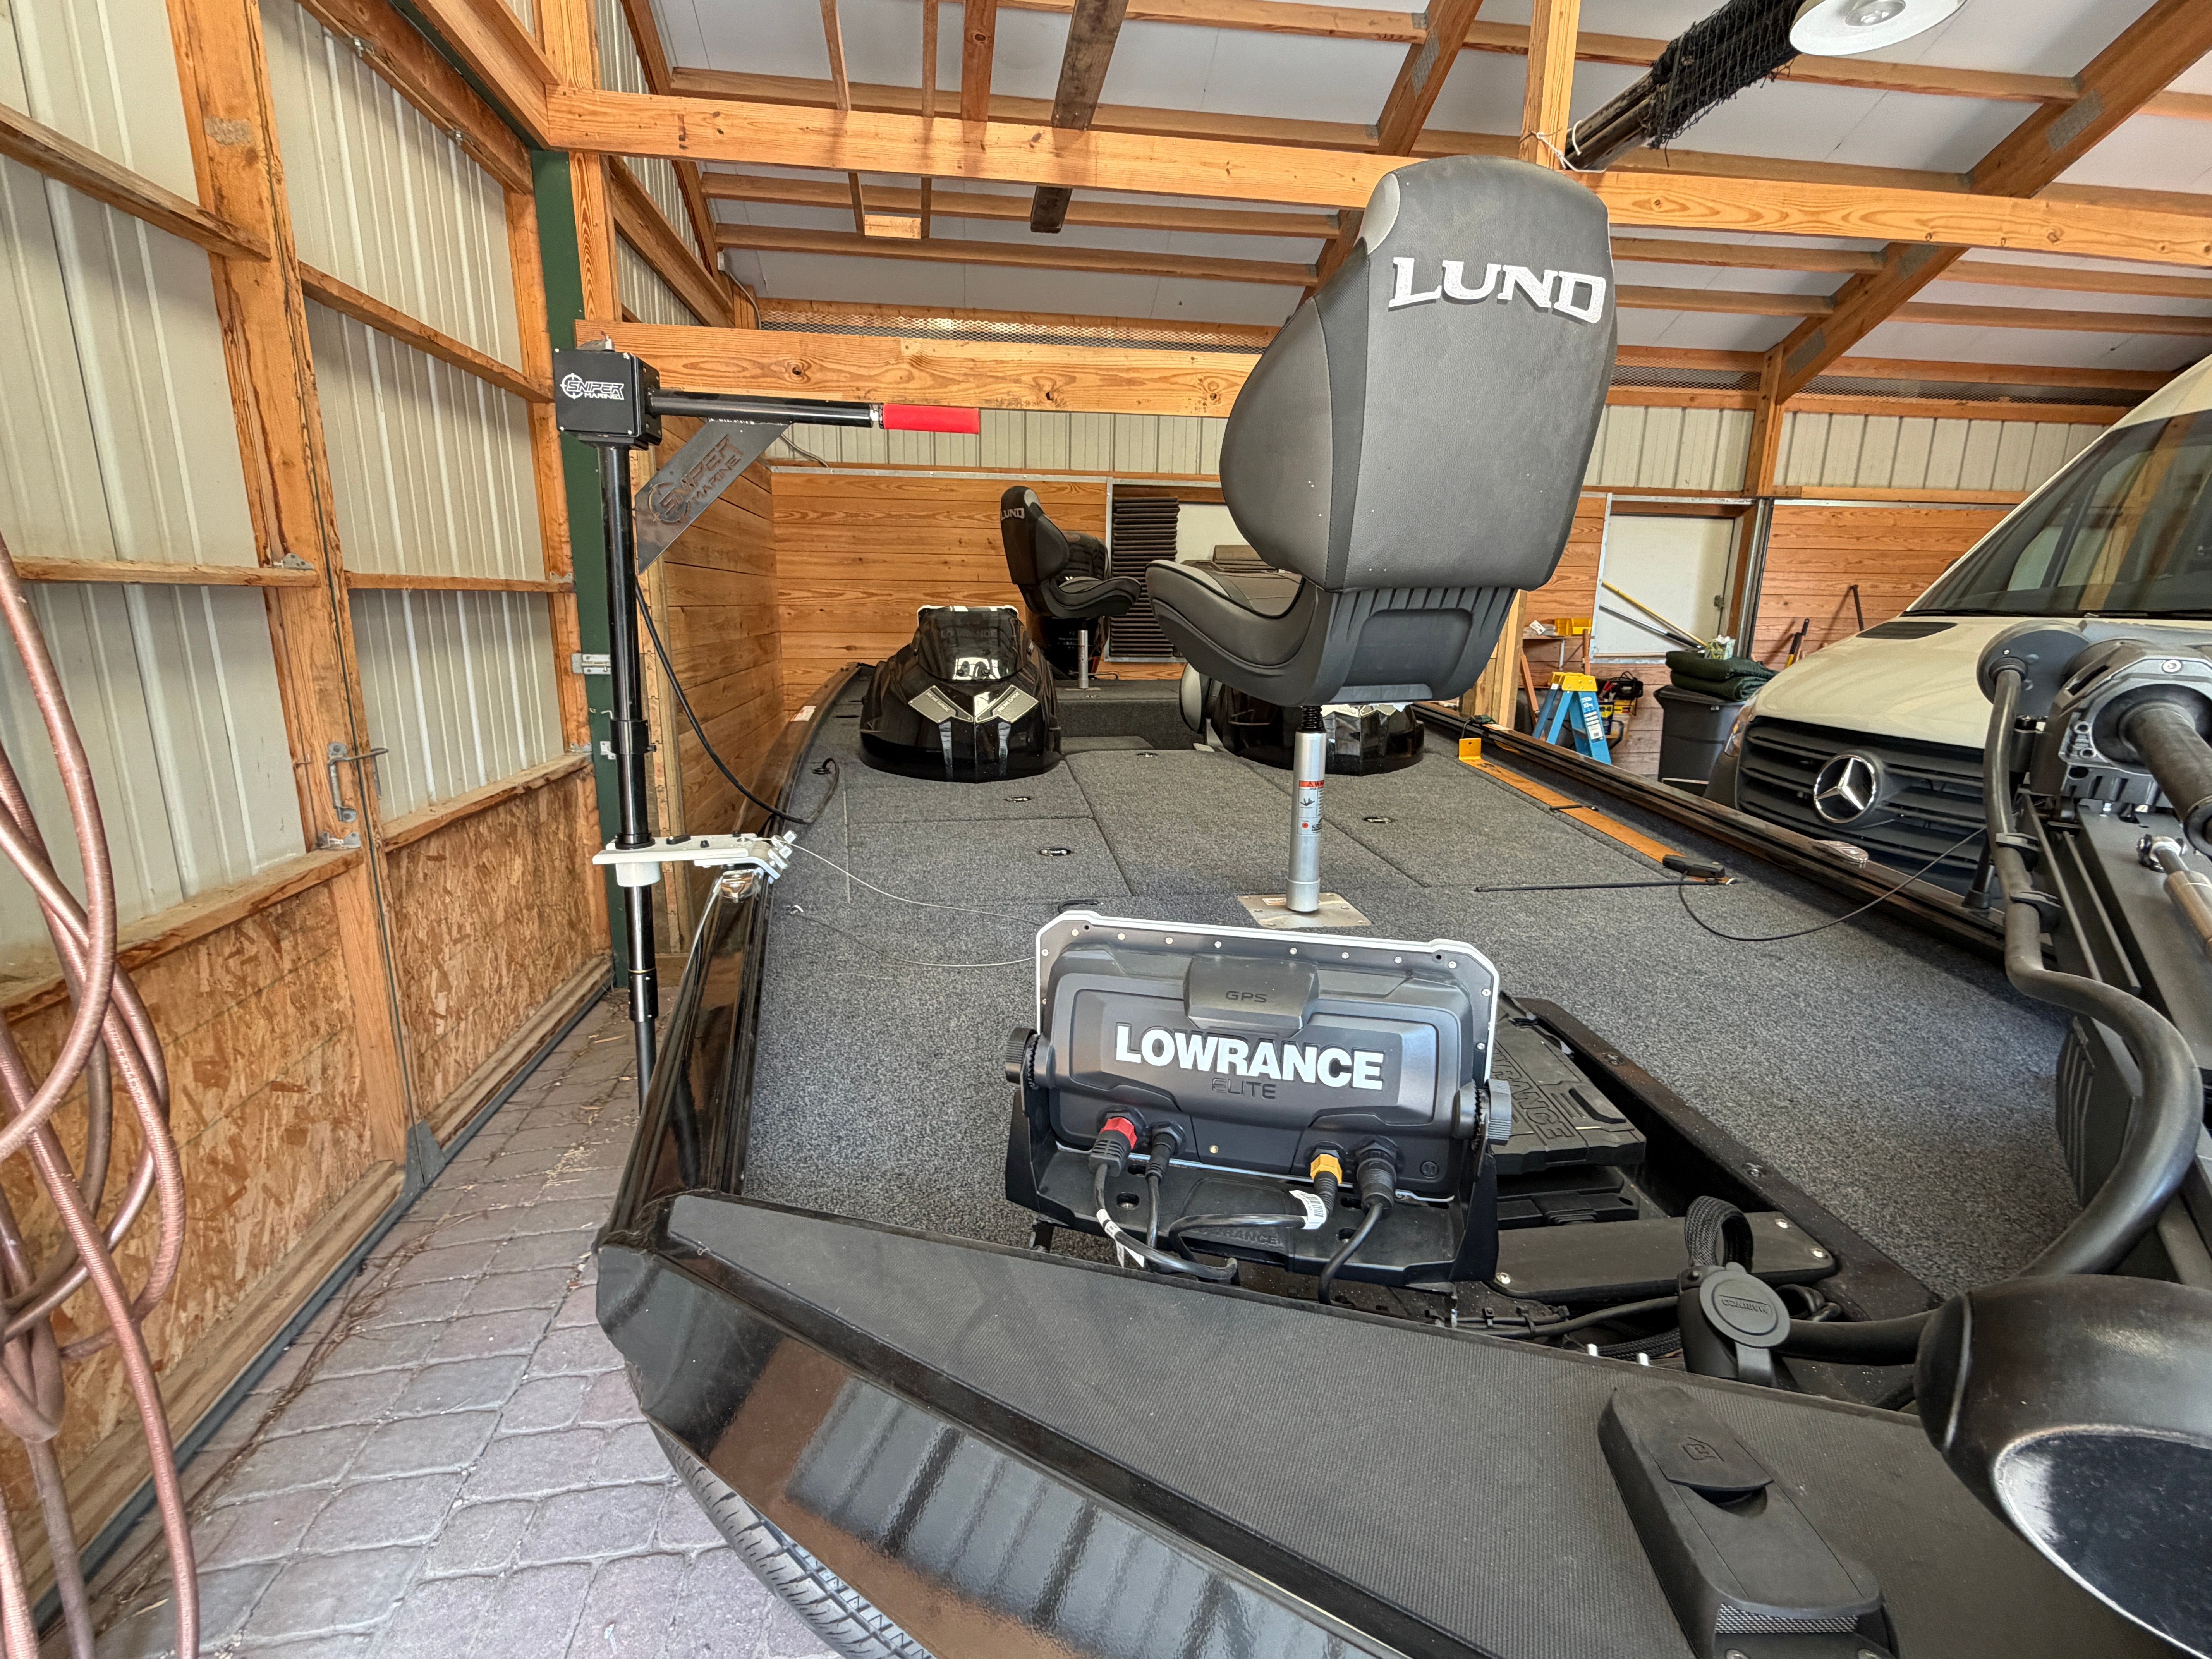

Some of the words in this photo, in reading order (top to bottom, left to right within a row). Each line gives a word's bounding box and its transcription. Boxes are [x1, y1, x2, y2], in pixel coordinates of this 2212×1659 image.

[1389, 257, 1606, 323] LUND
[566, 380, 624, 400] SNIPER
[659, 433, 743, 515] SNIPER
[691, 455, 742, 503] MARINE
[1001, 508, 1025, 520] LUND
[1226, 991, 1267, 1003] GPS
[1116, 1024, 1384, 1090] LOWRANCE
[1212, 1077, 1276, 1099] ELITE
